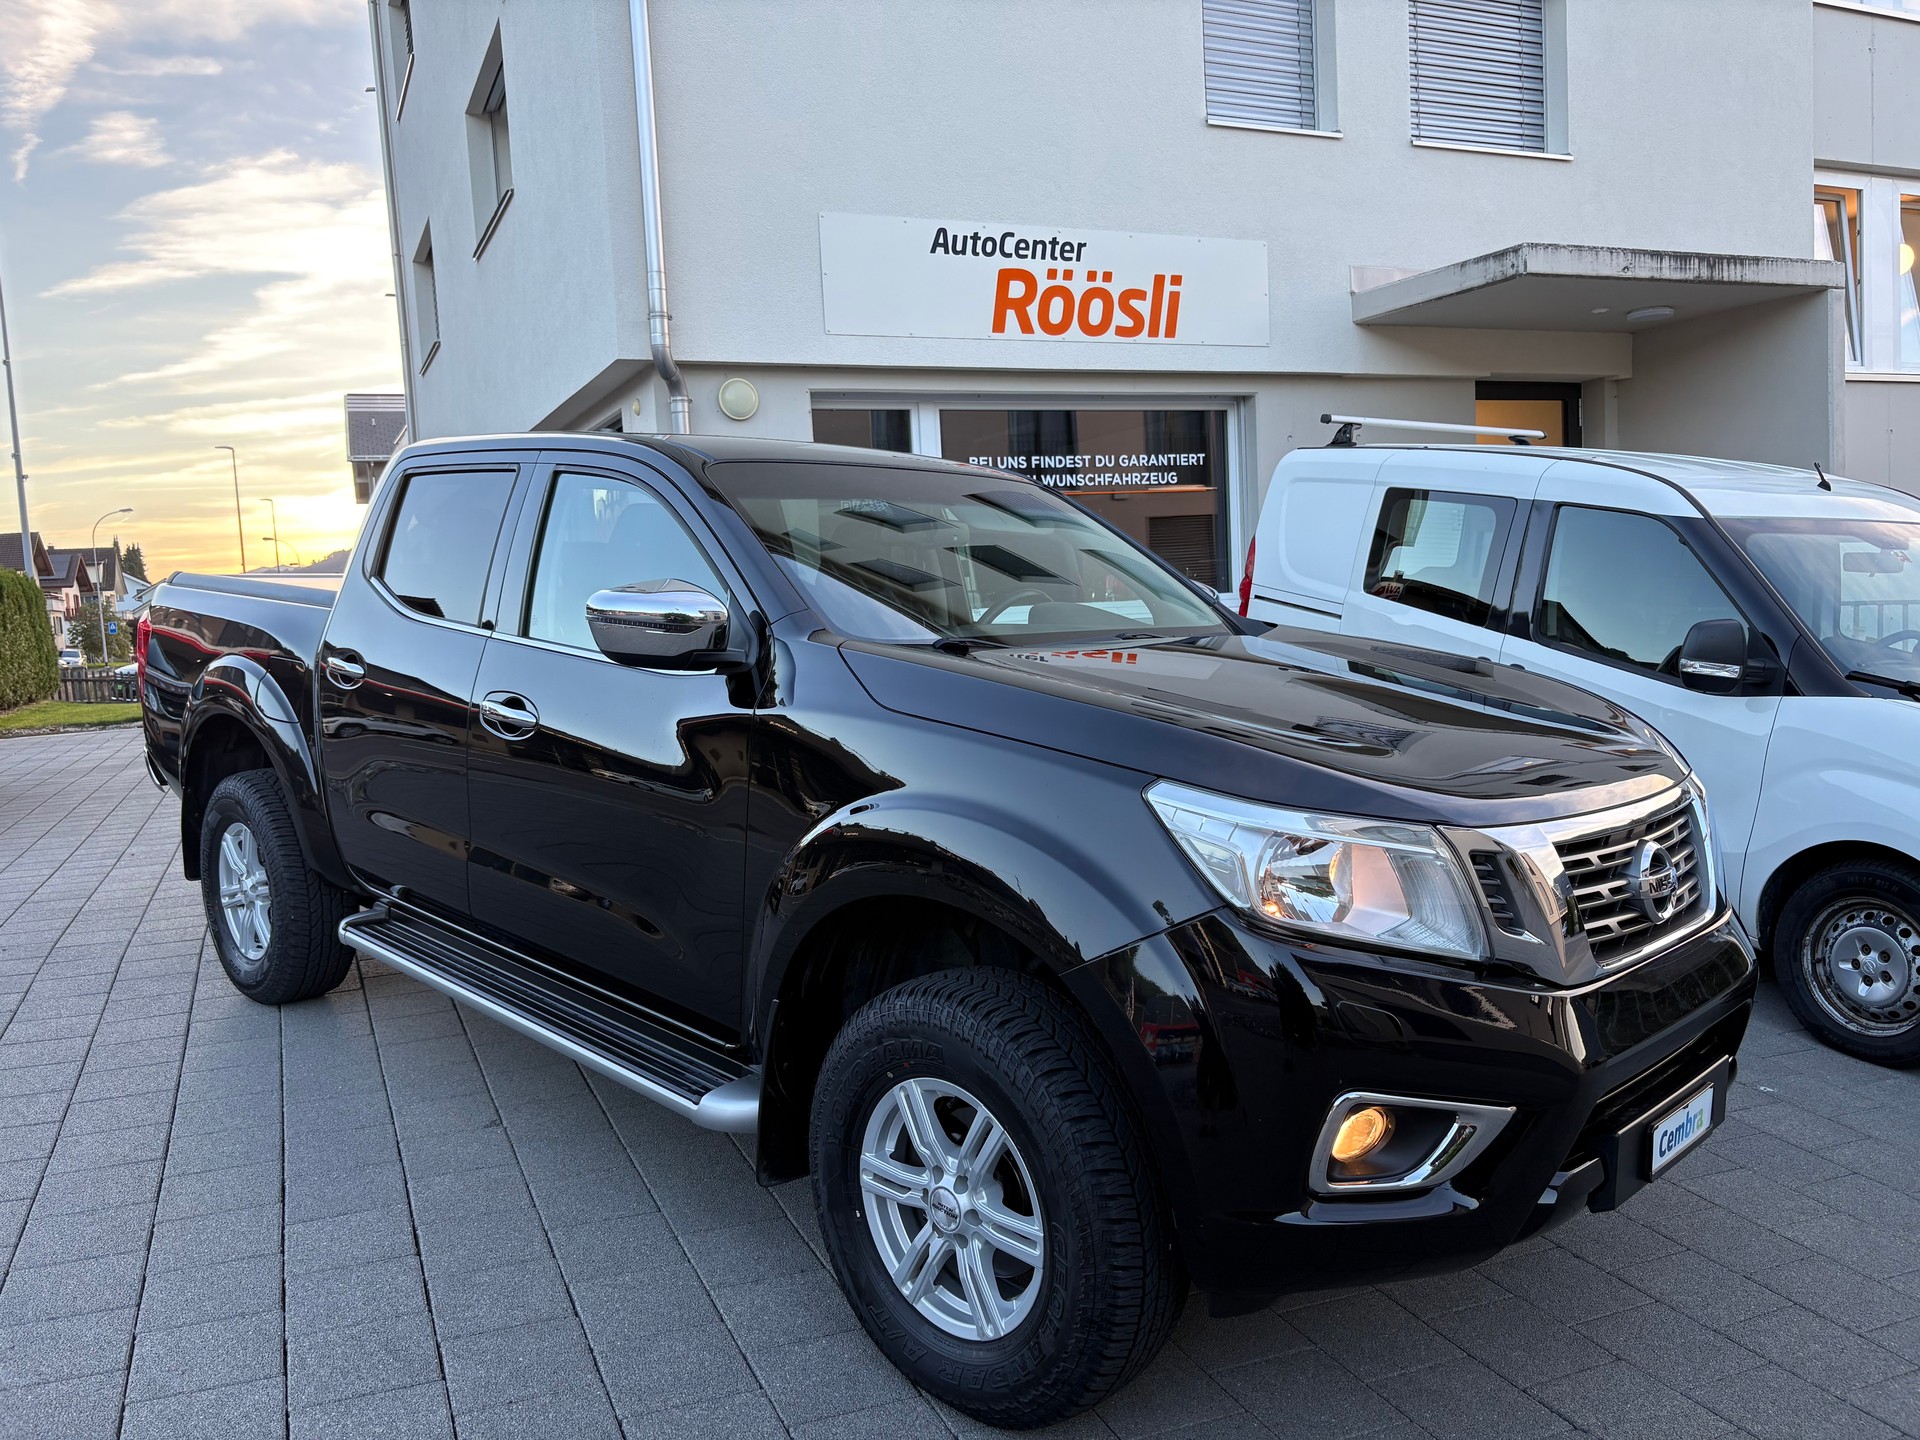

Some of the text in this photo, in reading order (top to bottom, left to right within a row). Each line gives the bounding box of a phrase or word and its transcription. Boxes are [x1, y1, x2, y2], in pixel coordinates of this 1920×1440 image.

[930, 227, 1087, 262] AutoCenter
[992, 267, 1183, 339] Röösli
[997, 456, 1027, 469] UNS
[1031, 455, 1091, 469] FINDEST
[1095, 454, 1115, 468] DU
[1119, 453, 1206, 467] GARANTIERT
[1042, 472, 1178, 487] WUNSCHFAHRZEUG
[1658, 1108, 1704, 1158] Cembra
